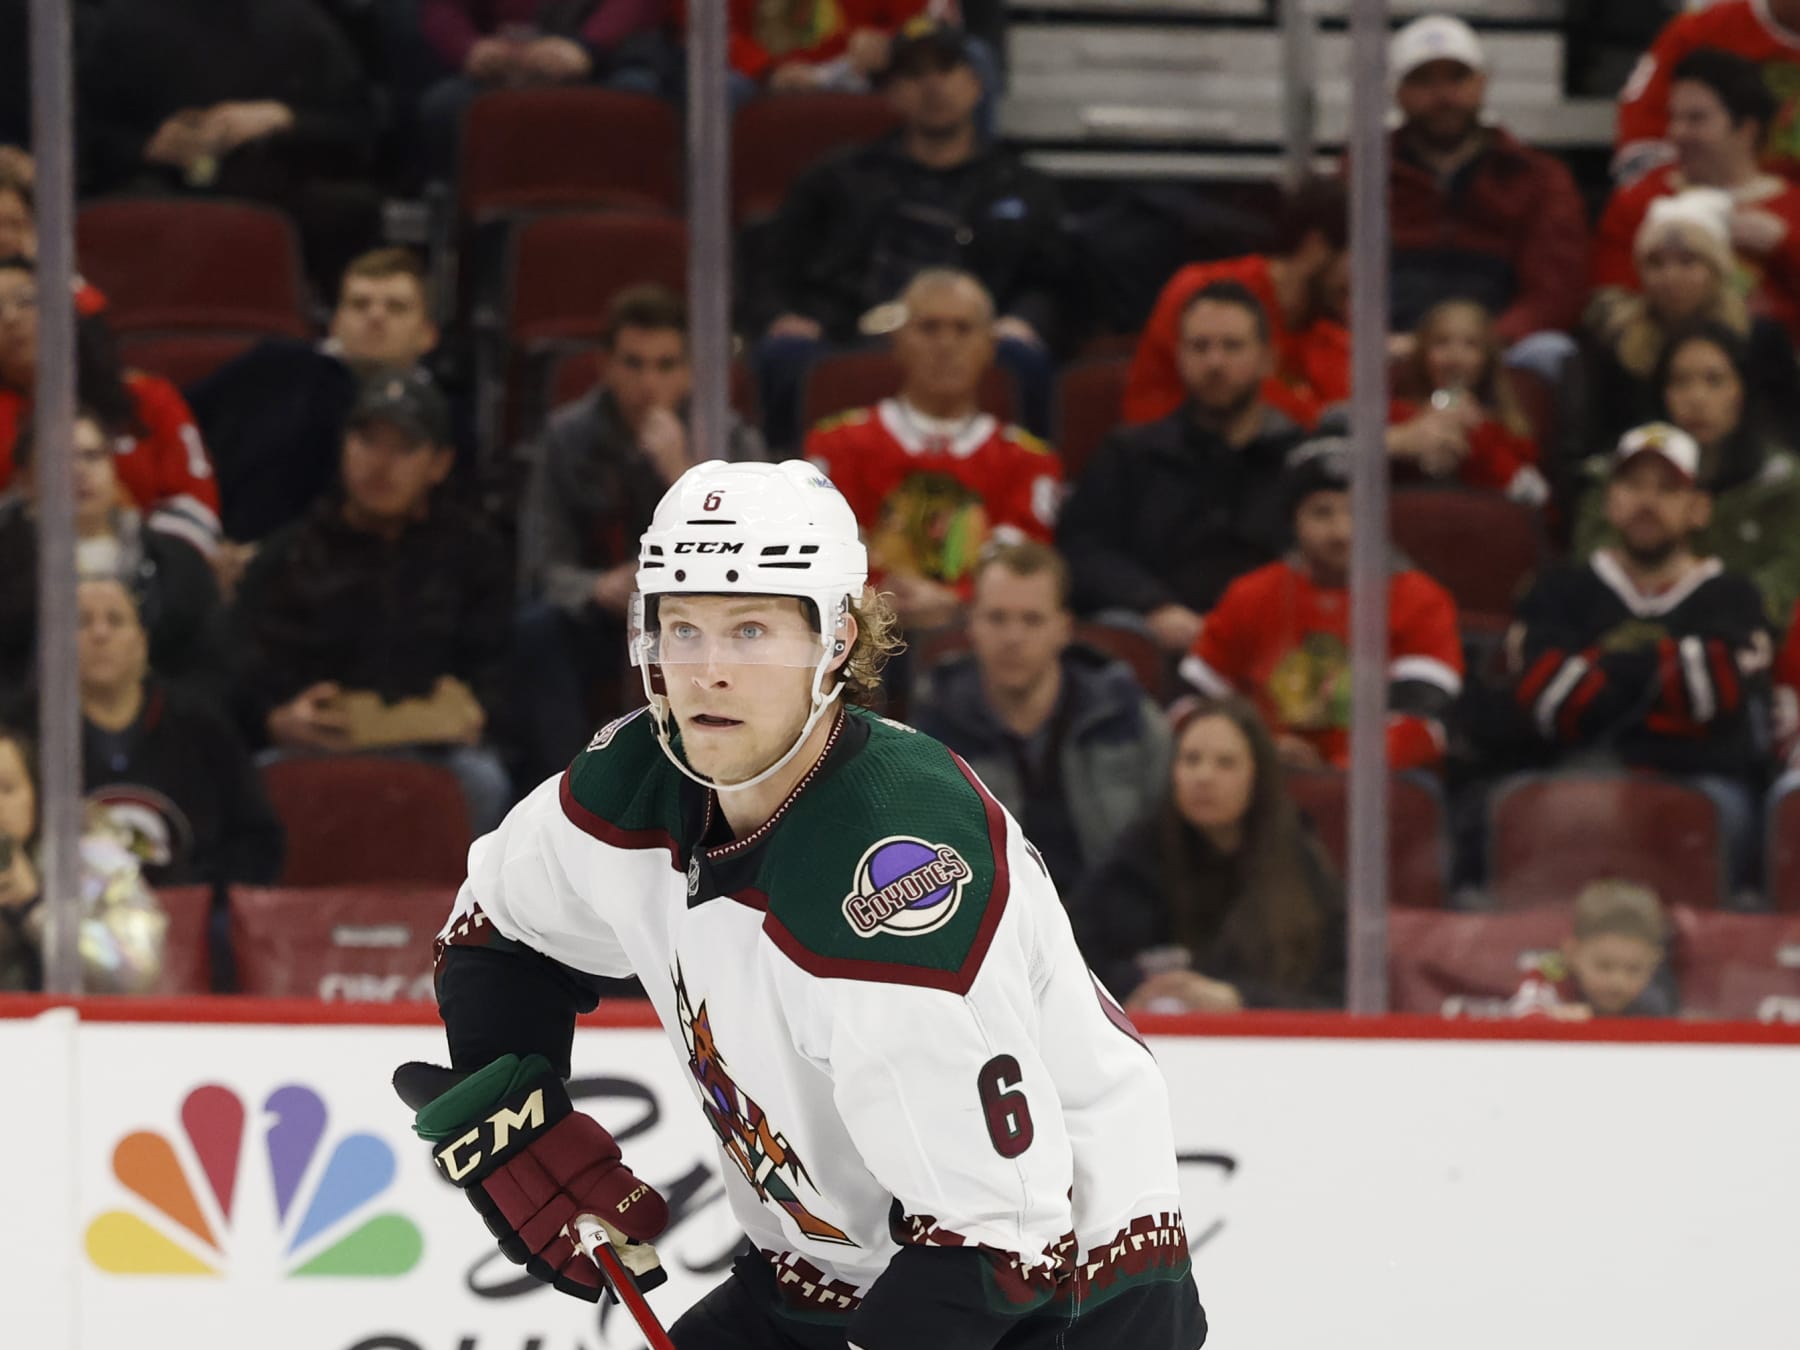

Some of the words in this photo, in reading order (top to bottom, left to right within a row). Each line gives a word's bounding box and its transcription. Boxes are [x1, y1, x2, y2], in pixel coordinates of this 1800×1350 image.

[703, 490, 726, 512] 6
[674, 542, 744, 554] CCM
[434, 1088, 545, 1181] CM
[977, 1053, 1034, 1159] 6
